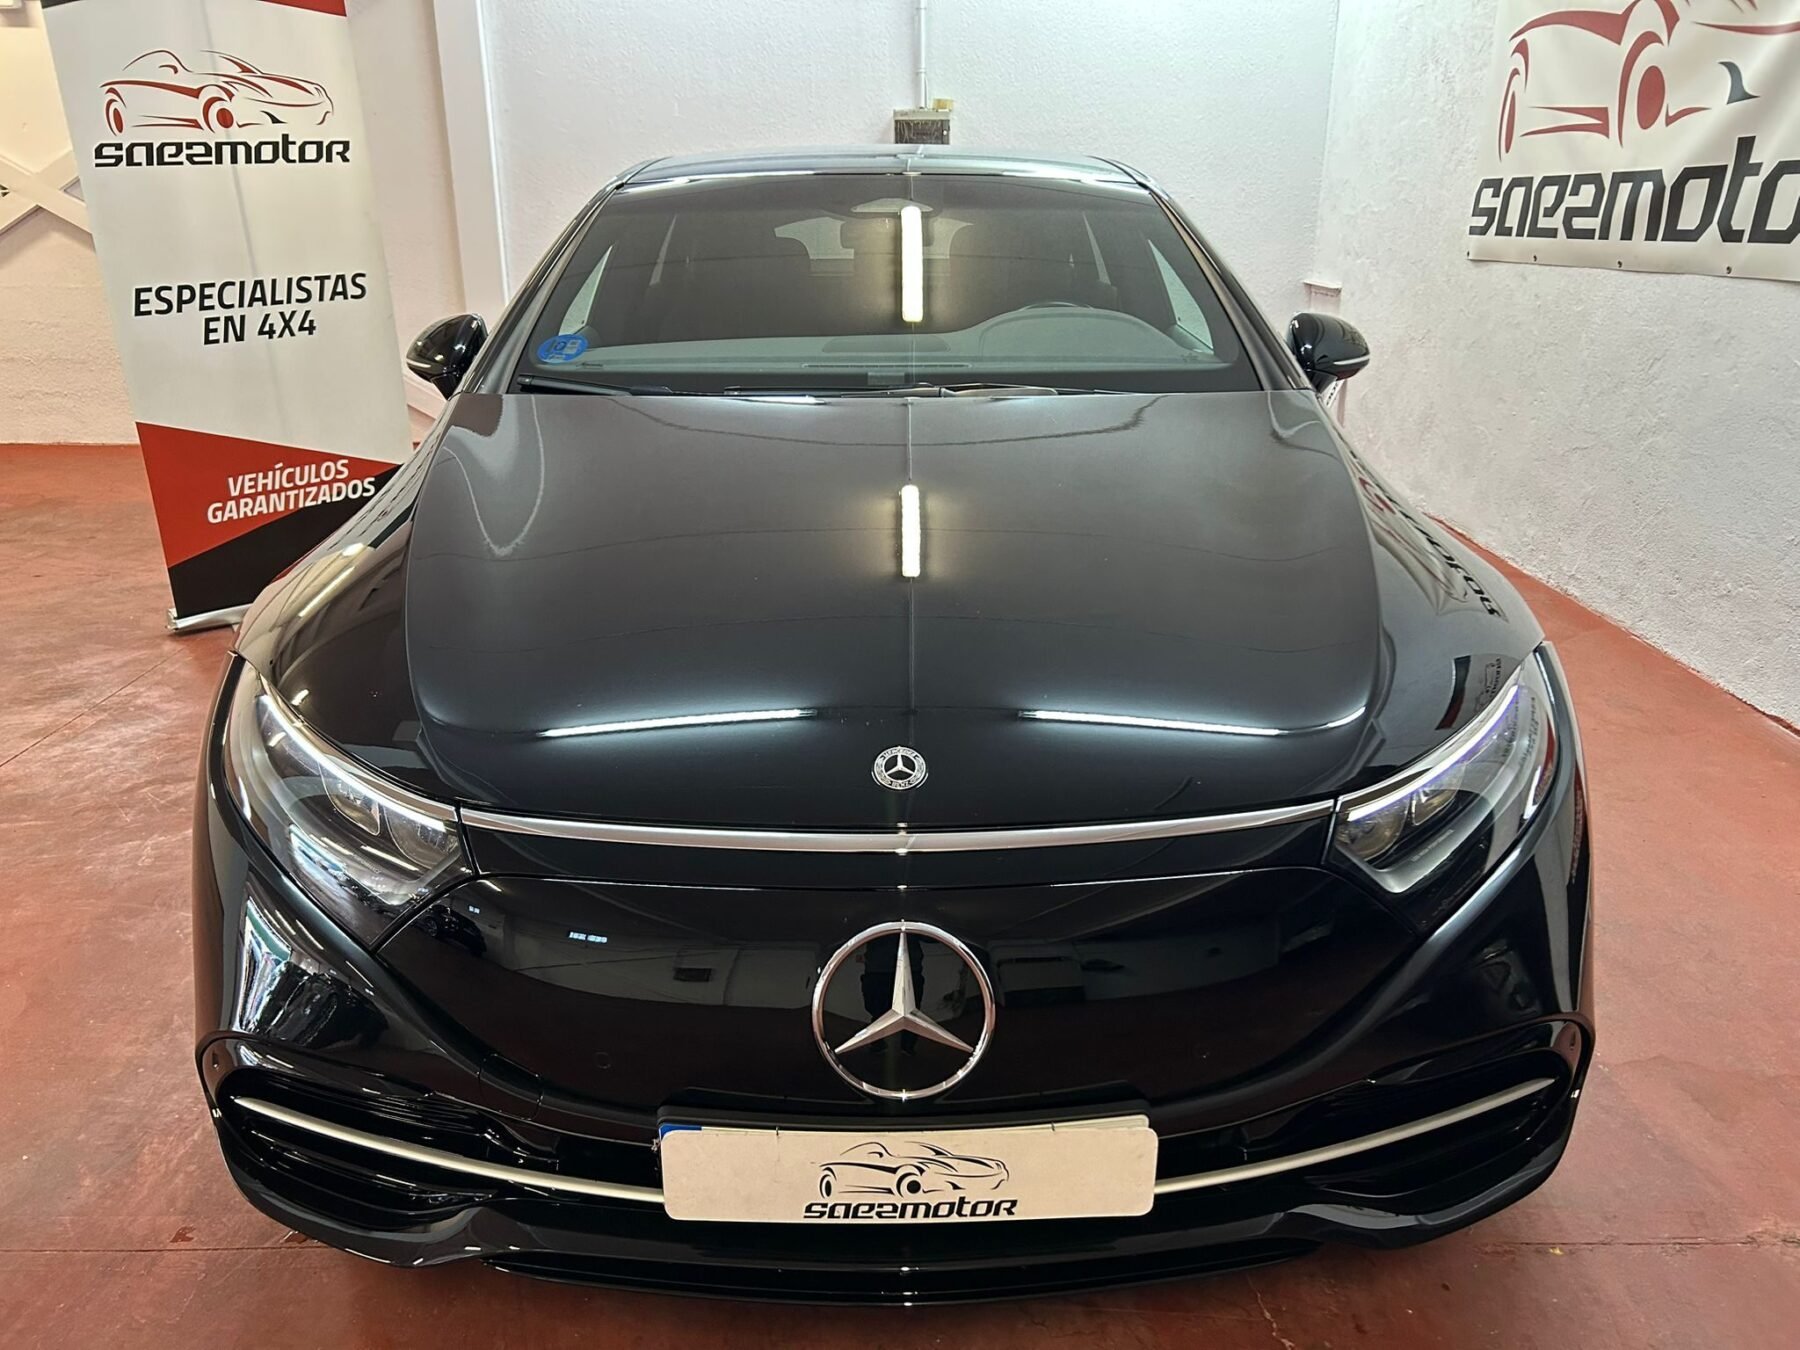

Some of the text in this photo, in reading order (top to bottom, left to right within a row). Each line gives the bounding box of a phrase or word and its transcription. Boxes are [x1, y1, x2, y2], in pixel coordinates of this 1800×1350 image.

[135, 273, 366, 317] ESPECIALISTAS
[203, 310, 317, 345] EN 4X4
[228, 459, 349, 497] VEHÍCULOS
[207, 477, 376, 524] GARANTIZADOS
